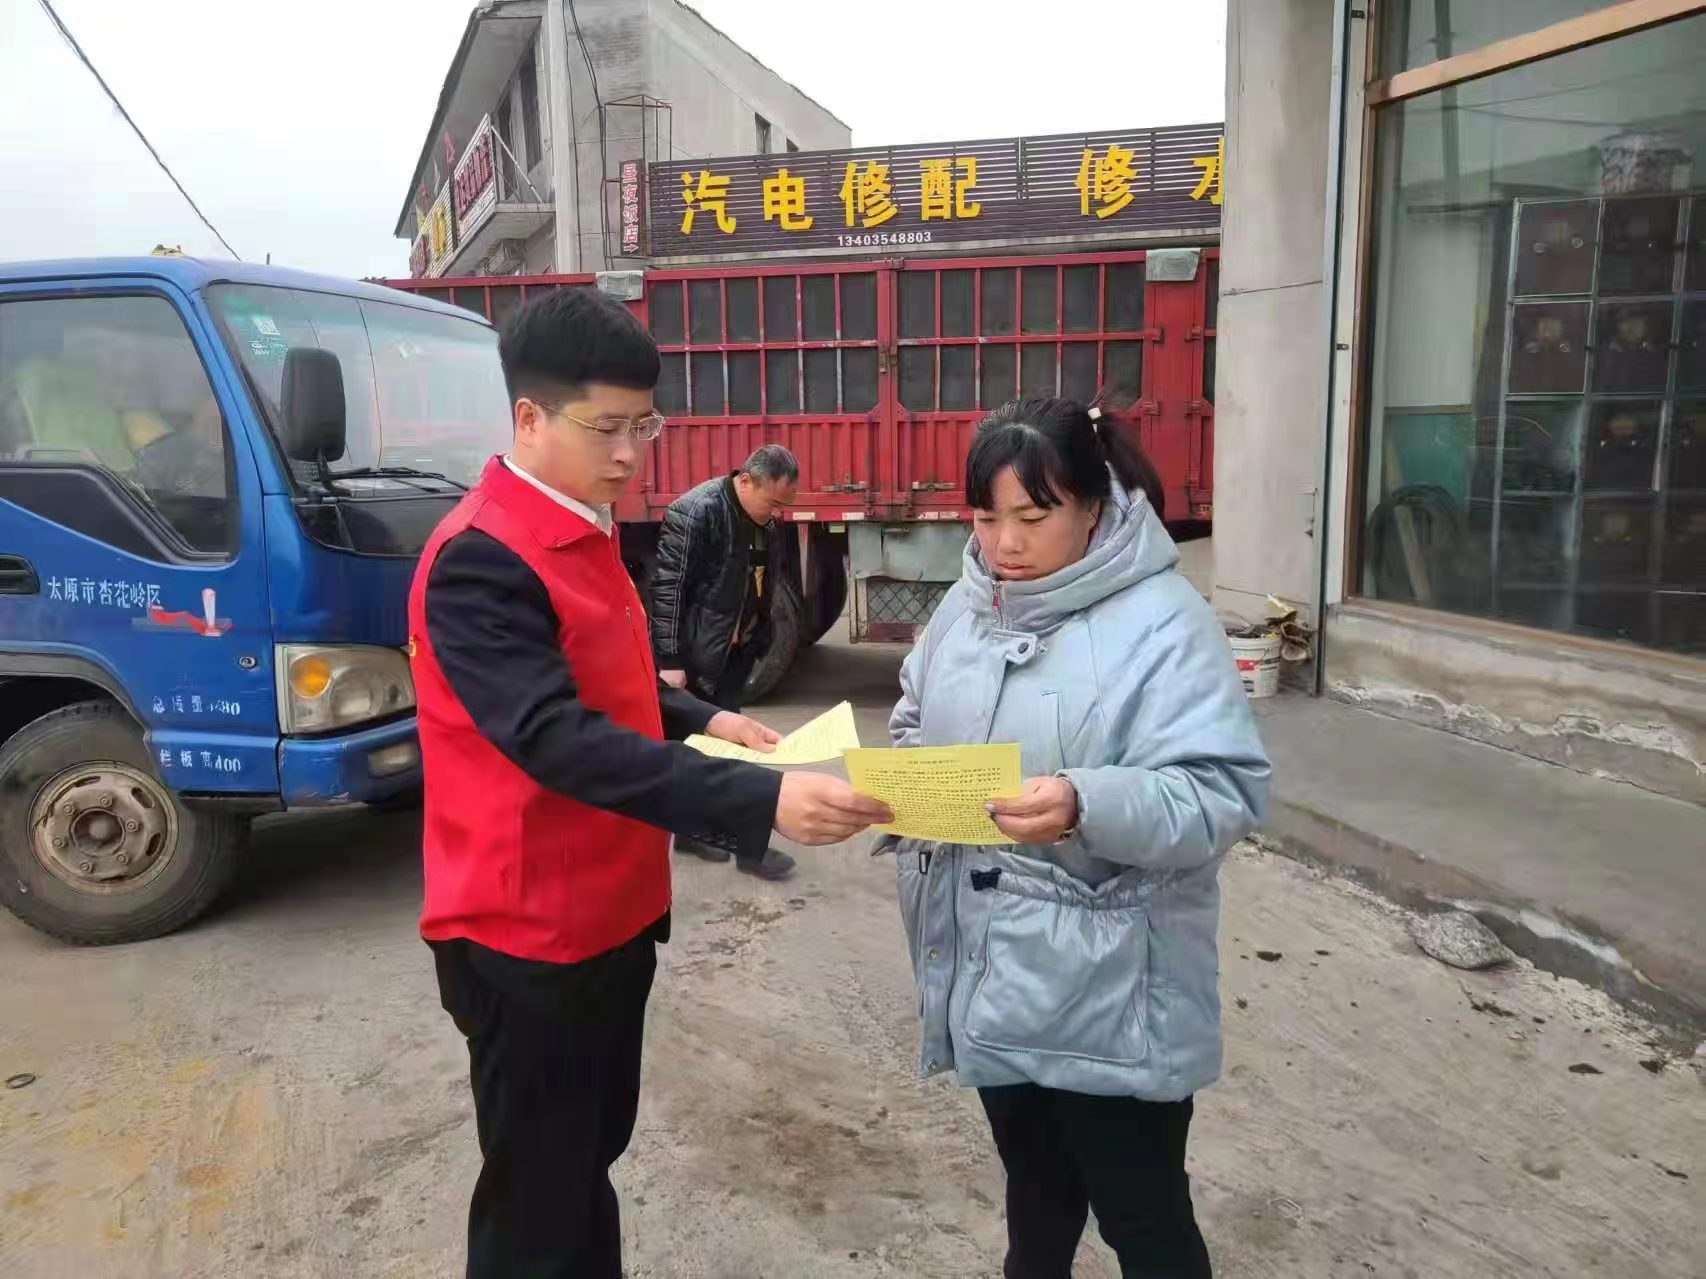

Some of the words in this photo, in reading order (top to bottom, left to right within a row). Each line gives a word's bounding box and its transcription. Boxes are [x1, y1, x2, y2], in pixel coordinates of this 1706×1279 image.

[680, 157, 981, 235] 汽电修配
[837, 231, 932, 247] 13403548803
[47, 576, 163, 609] 太原市杏花岭区
